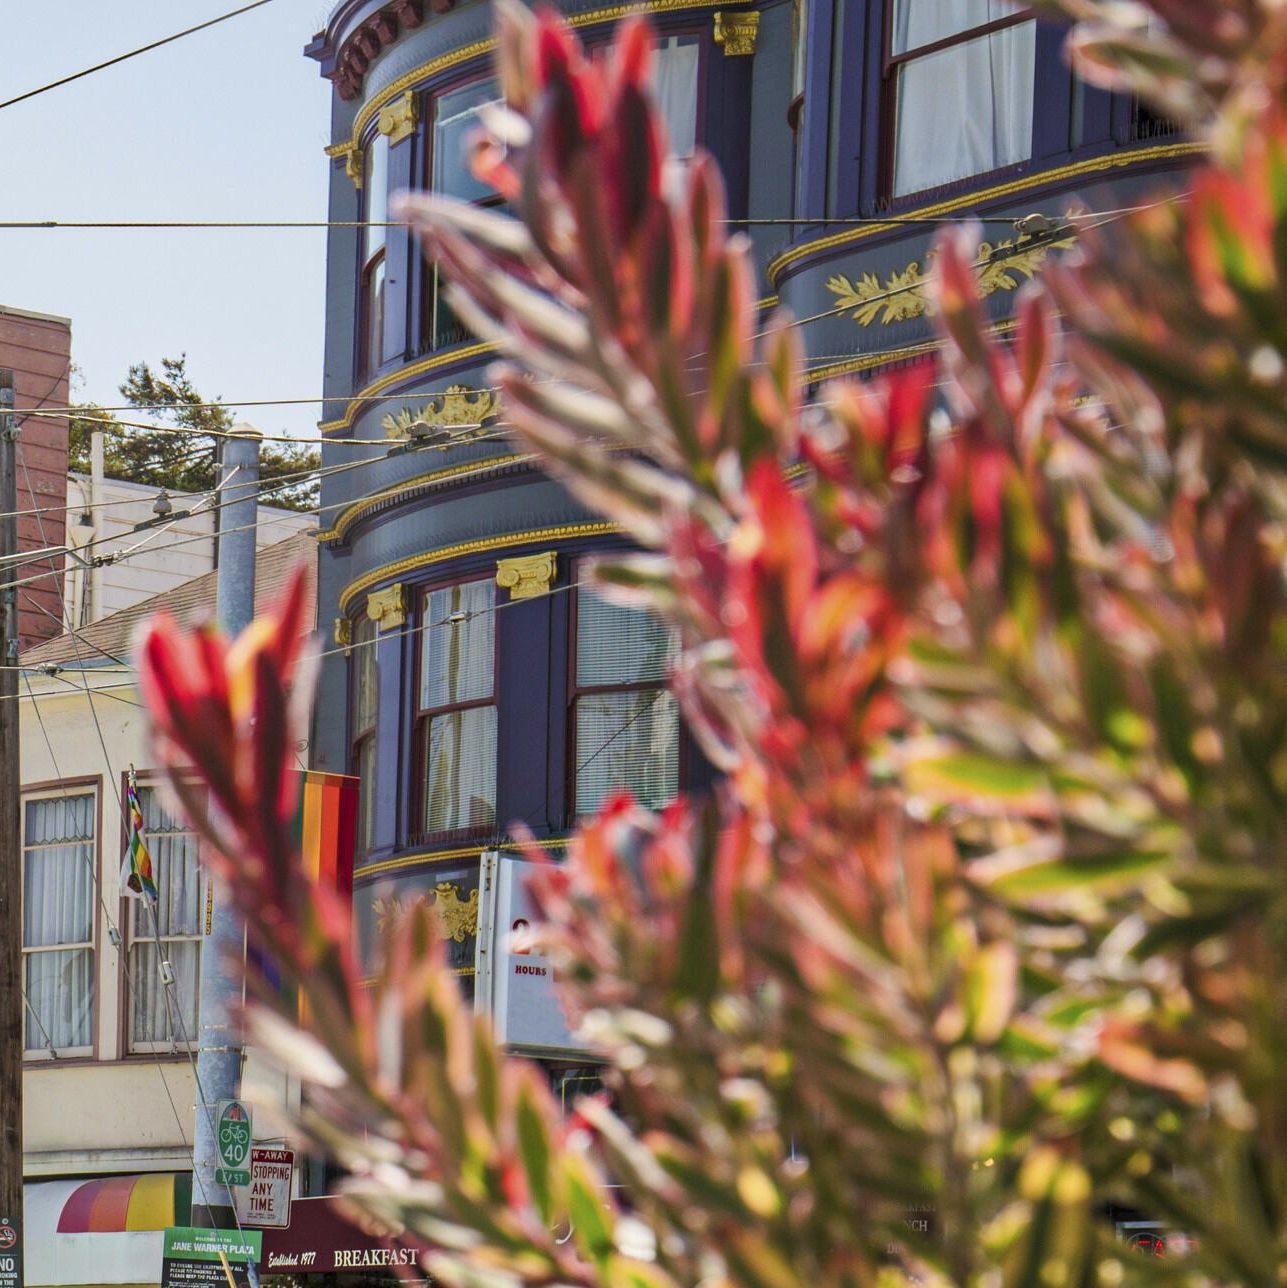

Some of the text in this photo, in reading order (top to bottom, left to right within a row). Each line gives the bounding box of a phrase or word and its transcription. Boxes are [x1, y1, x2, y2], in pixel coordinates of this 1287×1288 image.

[514, 964, 547, 976] HOURS
[224, 1144, 244, 1162] 40
[254, 1166, 290, 1180] STOPPING
[252, 1182, 274, 1195] ANY
[250, 1197, 275, 1212] TIME
[171, 1241, 255, 1255] JANE WARNER PLAZA
[268, 1248, 420, 1268] Established 1977 BREAKFAST
